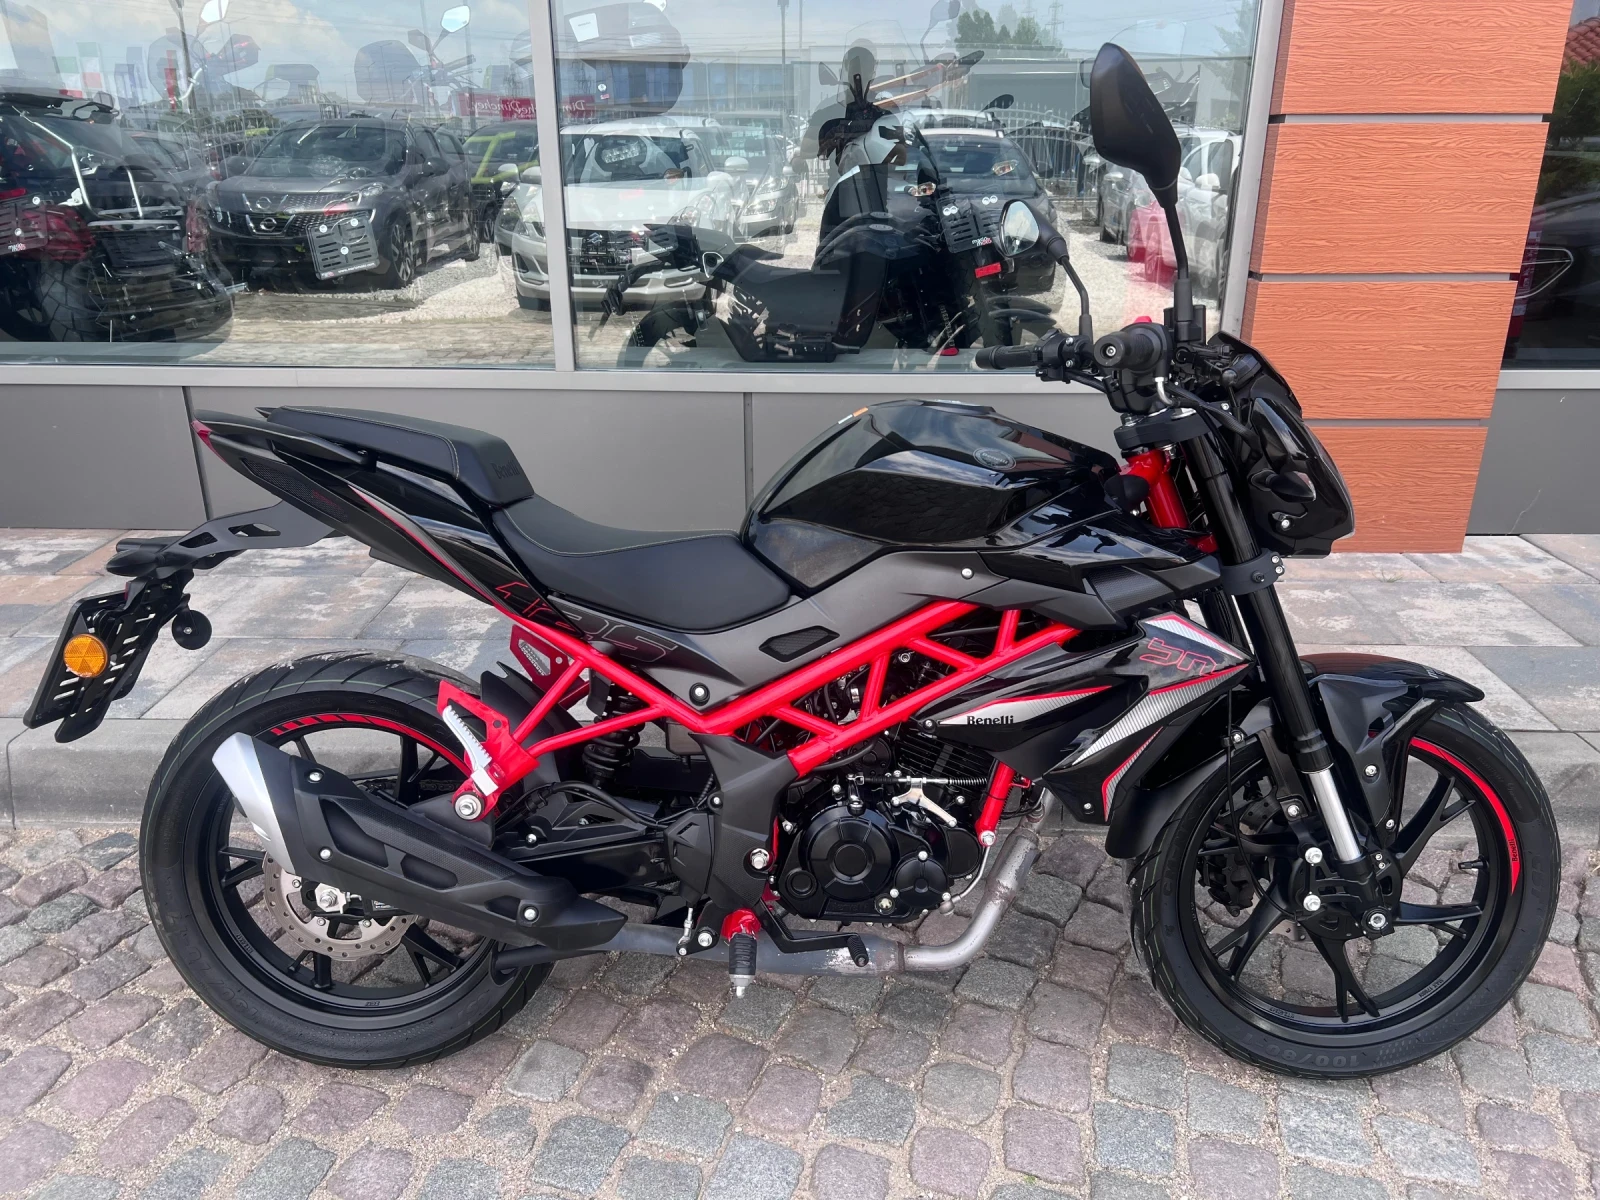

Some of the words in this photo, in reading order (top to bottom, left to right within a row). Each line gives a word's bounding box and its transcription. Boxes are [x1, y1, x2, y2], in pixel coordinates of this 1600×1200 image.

[489, 459, 520, 479] Benelli
[966, 714, 1014, 726] Benelli
[1509, 838, 1519, 862] Benelli
